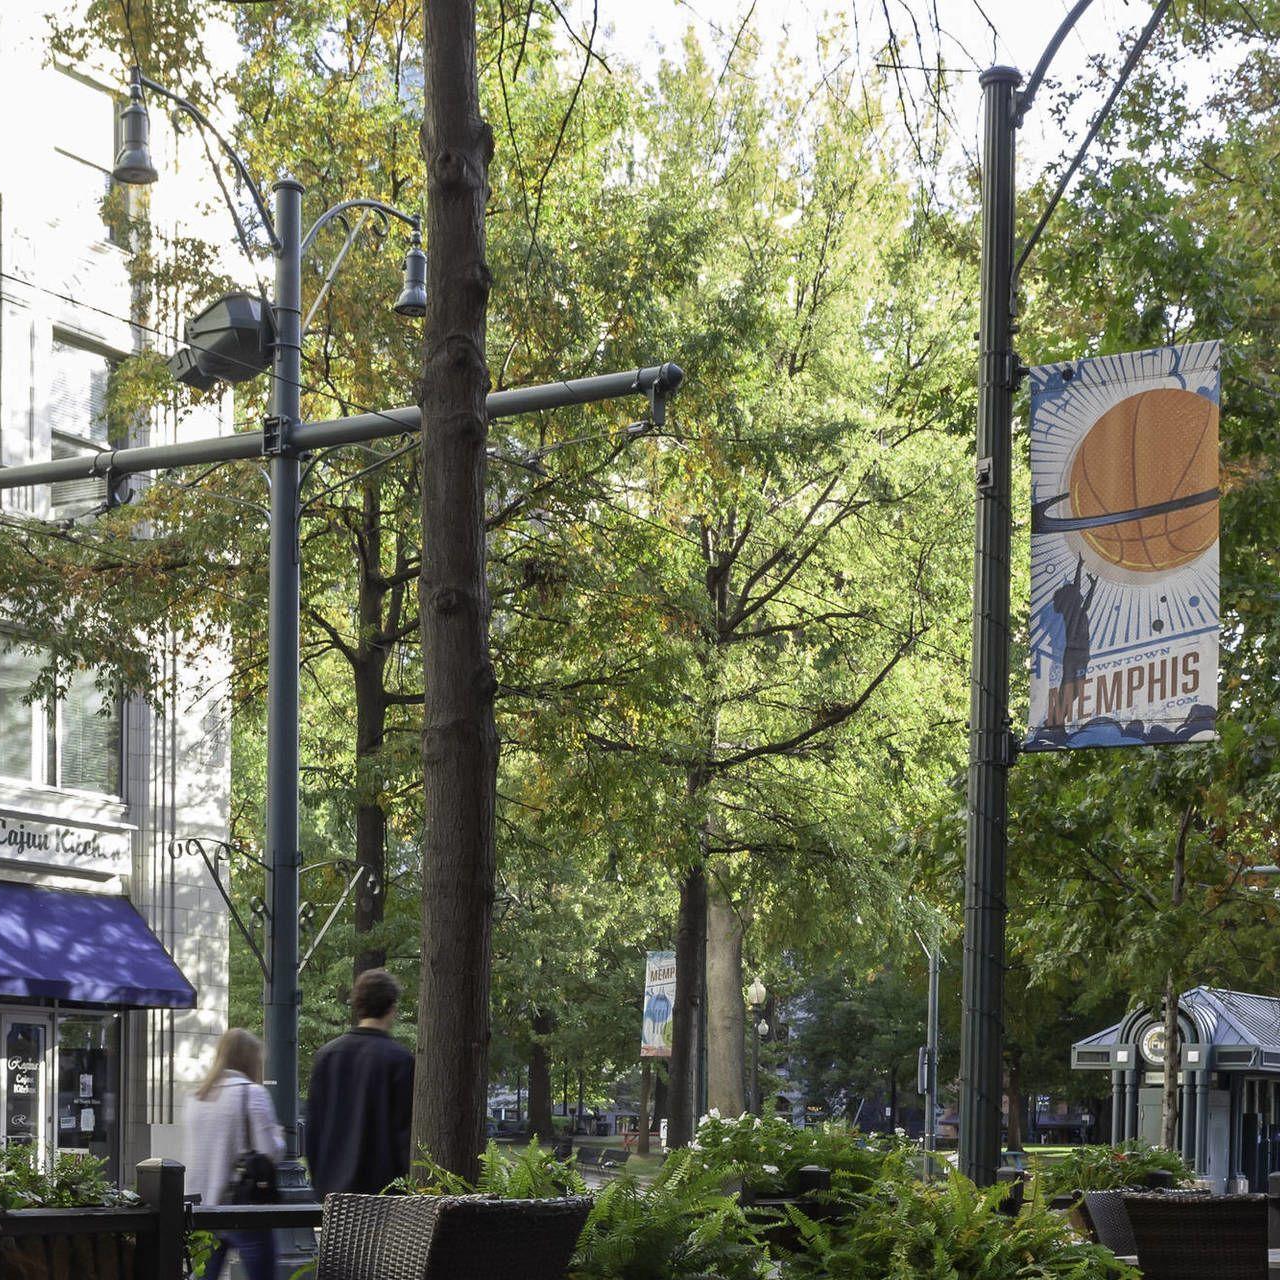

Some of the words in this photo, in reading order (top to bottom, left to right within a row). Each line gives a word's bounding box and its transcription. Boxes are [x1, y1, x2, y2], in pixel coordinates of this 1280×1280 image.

[1076, 646, 1171, 677] DOWNTOWN
[1046, 651, 1200, 727] MEMPHIS
[650, 966, 676, 982] MEMP
